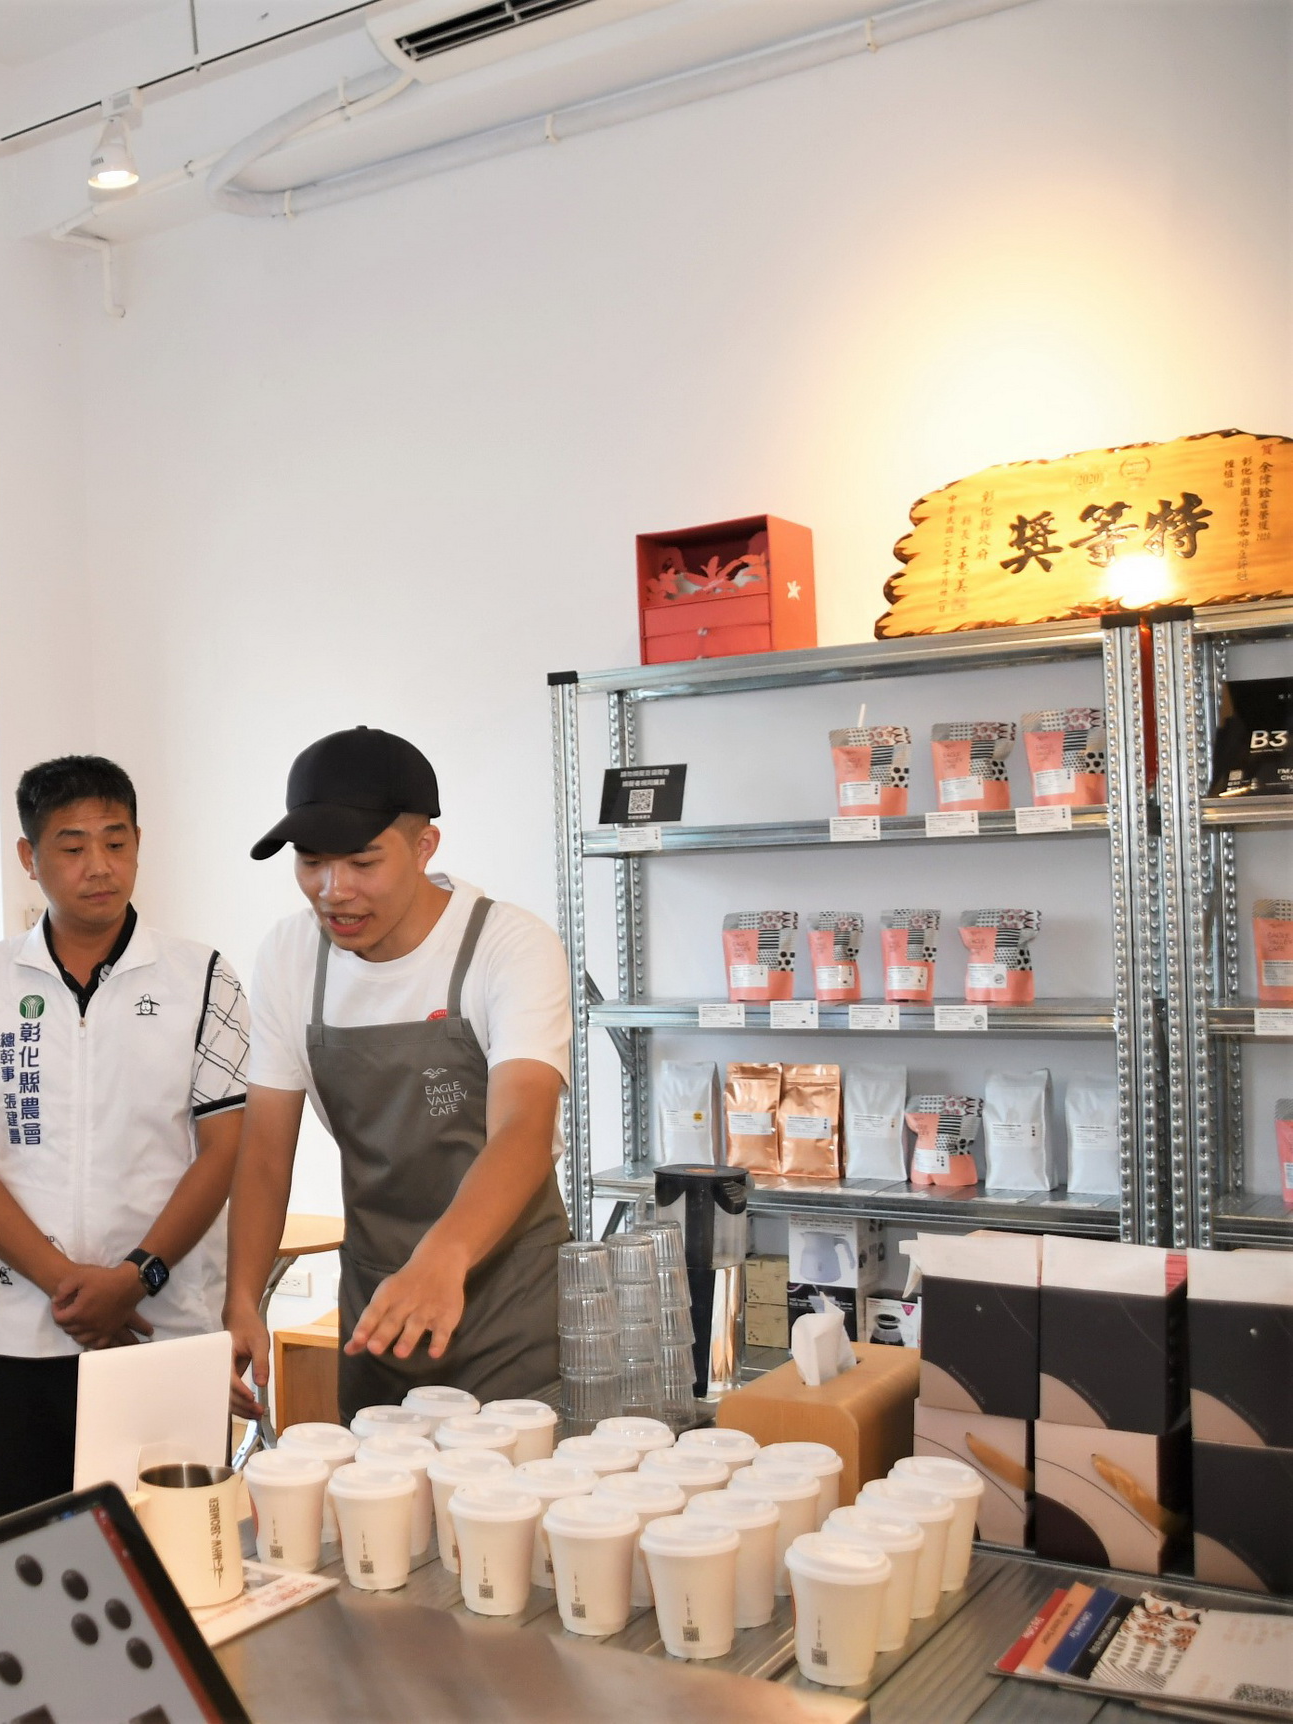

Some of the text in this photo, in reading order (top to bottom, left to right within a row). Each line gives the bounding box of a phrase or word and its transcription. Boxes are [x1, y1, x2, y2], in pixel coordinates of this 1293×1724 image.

[1000, 491, 1214, 575] 特等獎
[0, 1032, 15, 1083] 總幹事
[19, 1021, 41, 1146] 彰化縣農會
[425, 1081, 461, 1095] EAGLE
[427, 1090, 468, 1106] VALLEY
[429, 1103, 459, 1117] CAFE
